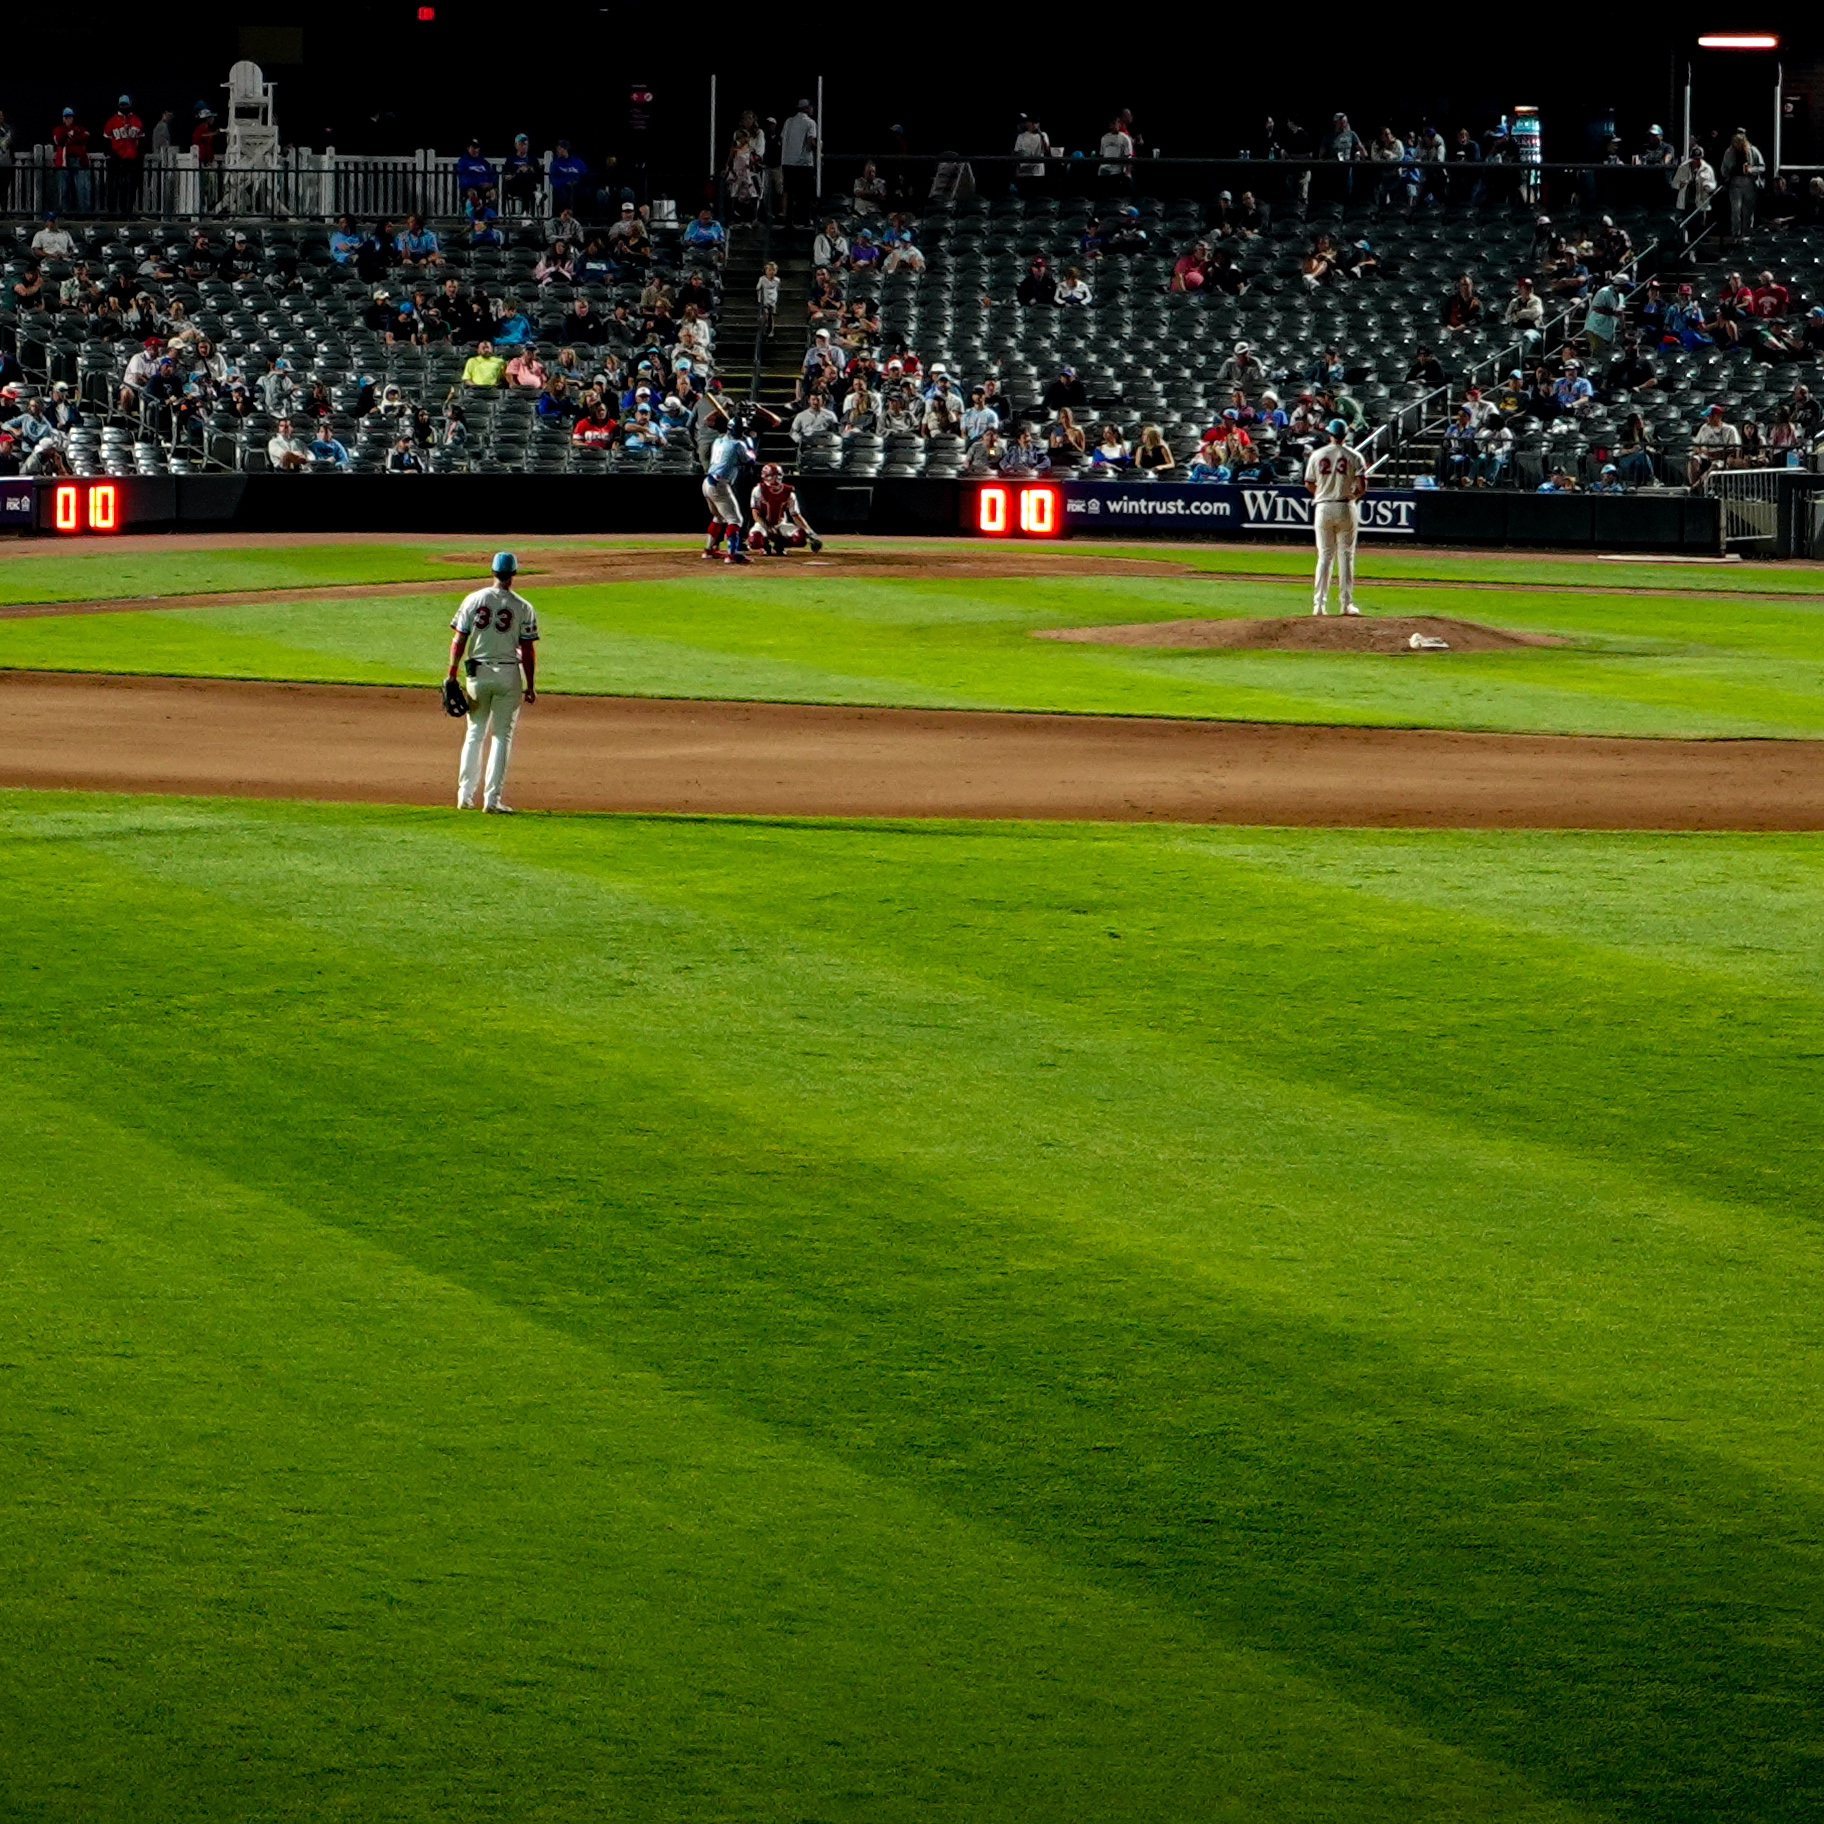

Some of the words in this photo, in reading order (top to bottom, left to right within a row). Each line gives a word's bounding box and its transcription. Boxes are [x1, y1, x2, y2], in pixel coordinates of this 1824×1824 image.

[1319, 457, 1348, 475] 23
[1106, 497, 1231, 517] wintrust.com
[1240, 490, 1417, 526] WINUST
[475, 606, 513, 633] 33
